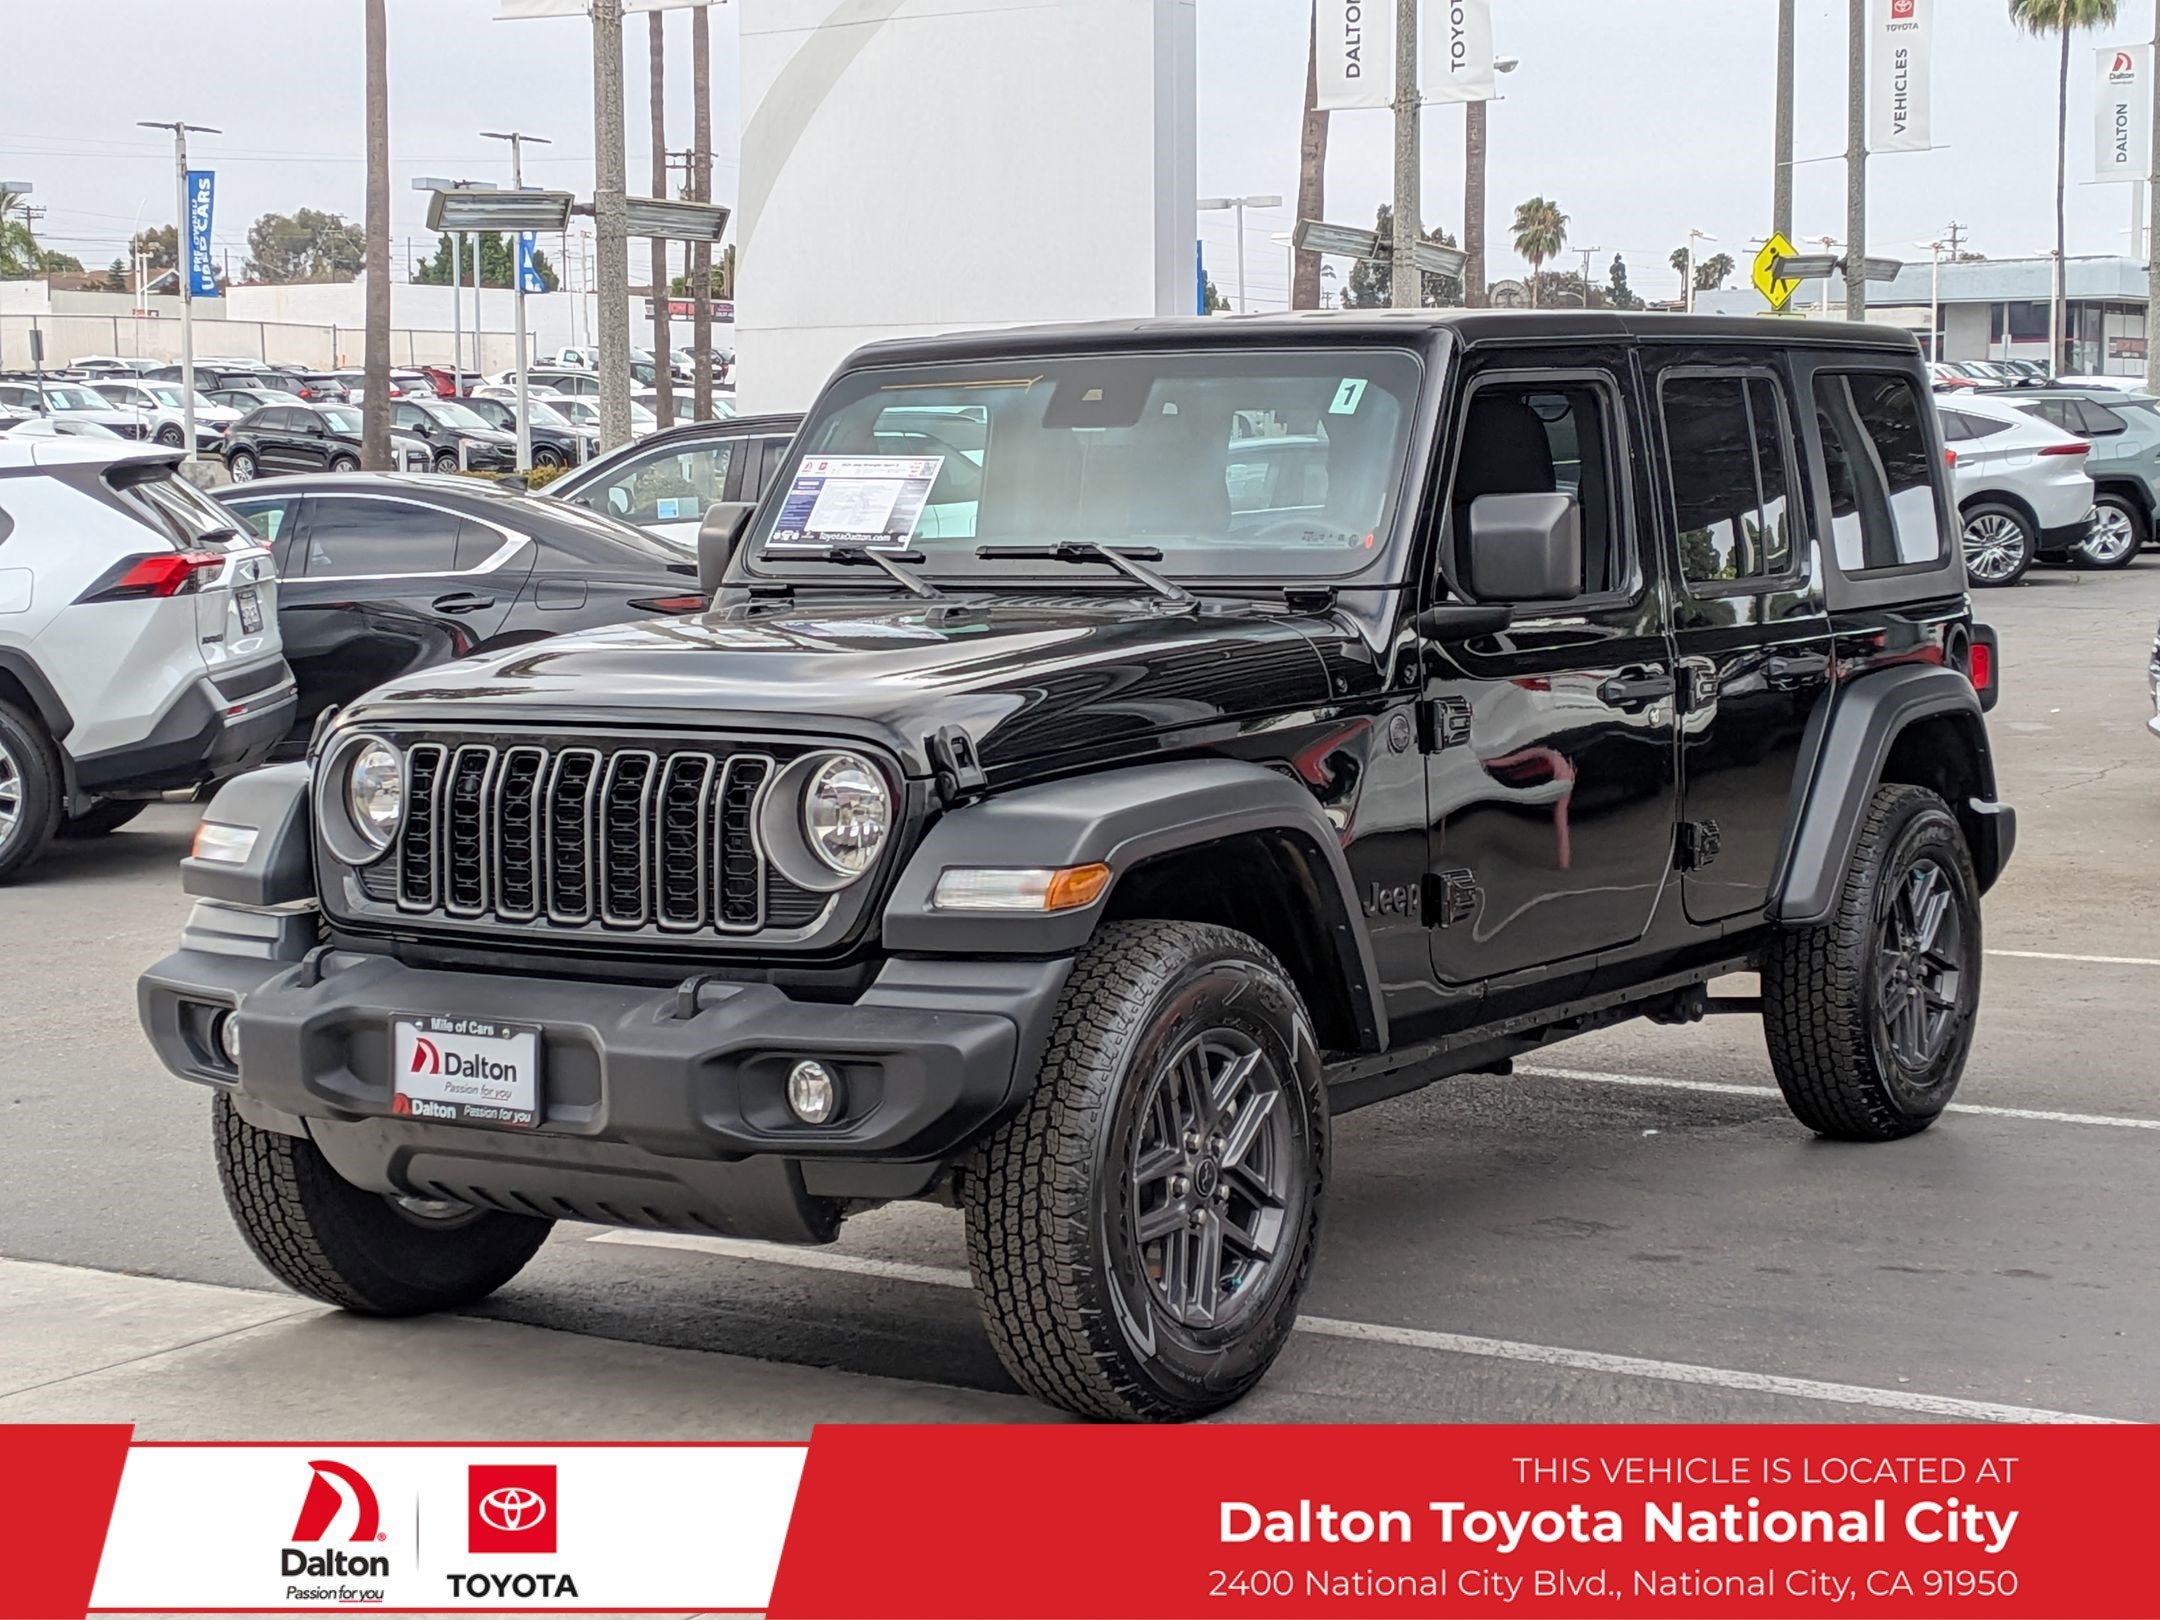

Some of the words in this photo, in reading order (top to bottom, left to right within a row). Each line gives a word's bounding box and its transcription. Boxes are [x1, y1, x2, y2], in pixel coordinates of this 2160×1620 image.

[1345, 0, 1361, 79] DALTO
[1886, 22, 1919, 32] TOYOTA
[1893, 48, 1908, 135] VEHICLES
[2115, 103, 2128, 163] DALTON
[197, 178, 211, 232] CARS
[1343, 383, 1357, 406] 1
[1362, 882, 1419, 918] Jeep
[431, 1017, 453, 1033] Mile
[455, 1020, 467, 1034] of
[469, 1021, 495, 1037] Cars
[444, 1052, 517, 1082] Dalton
[444, 1081, 479, 1096] Passion
[480, 1084, 494, 1098] for
[495, 1088, 513, 1101] you
[411, 1099, 457, 1120] Dalton
[464, 1105, 498, 1119] Passion
[499, 1108, 513, 1122] for
[513, 1111, 531, 1125] you
